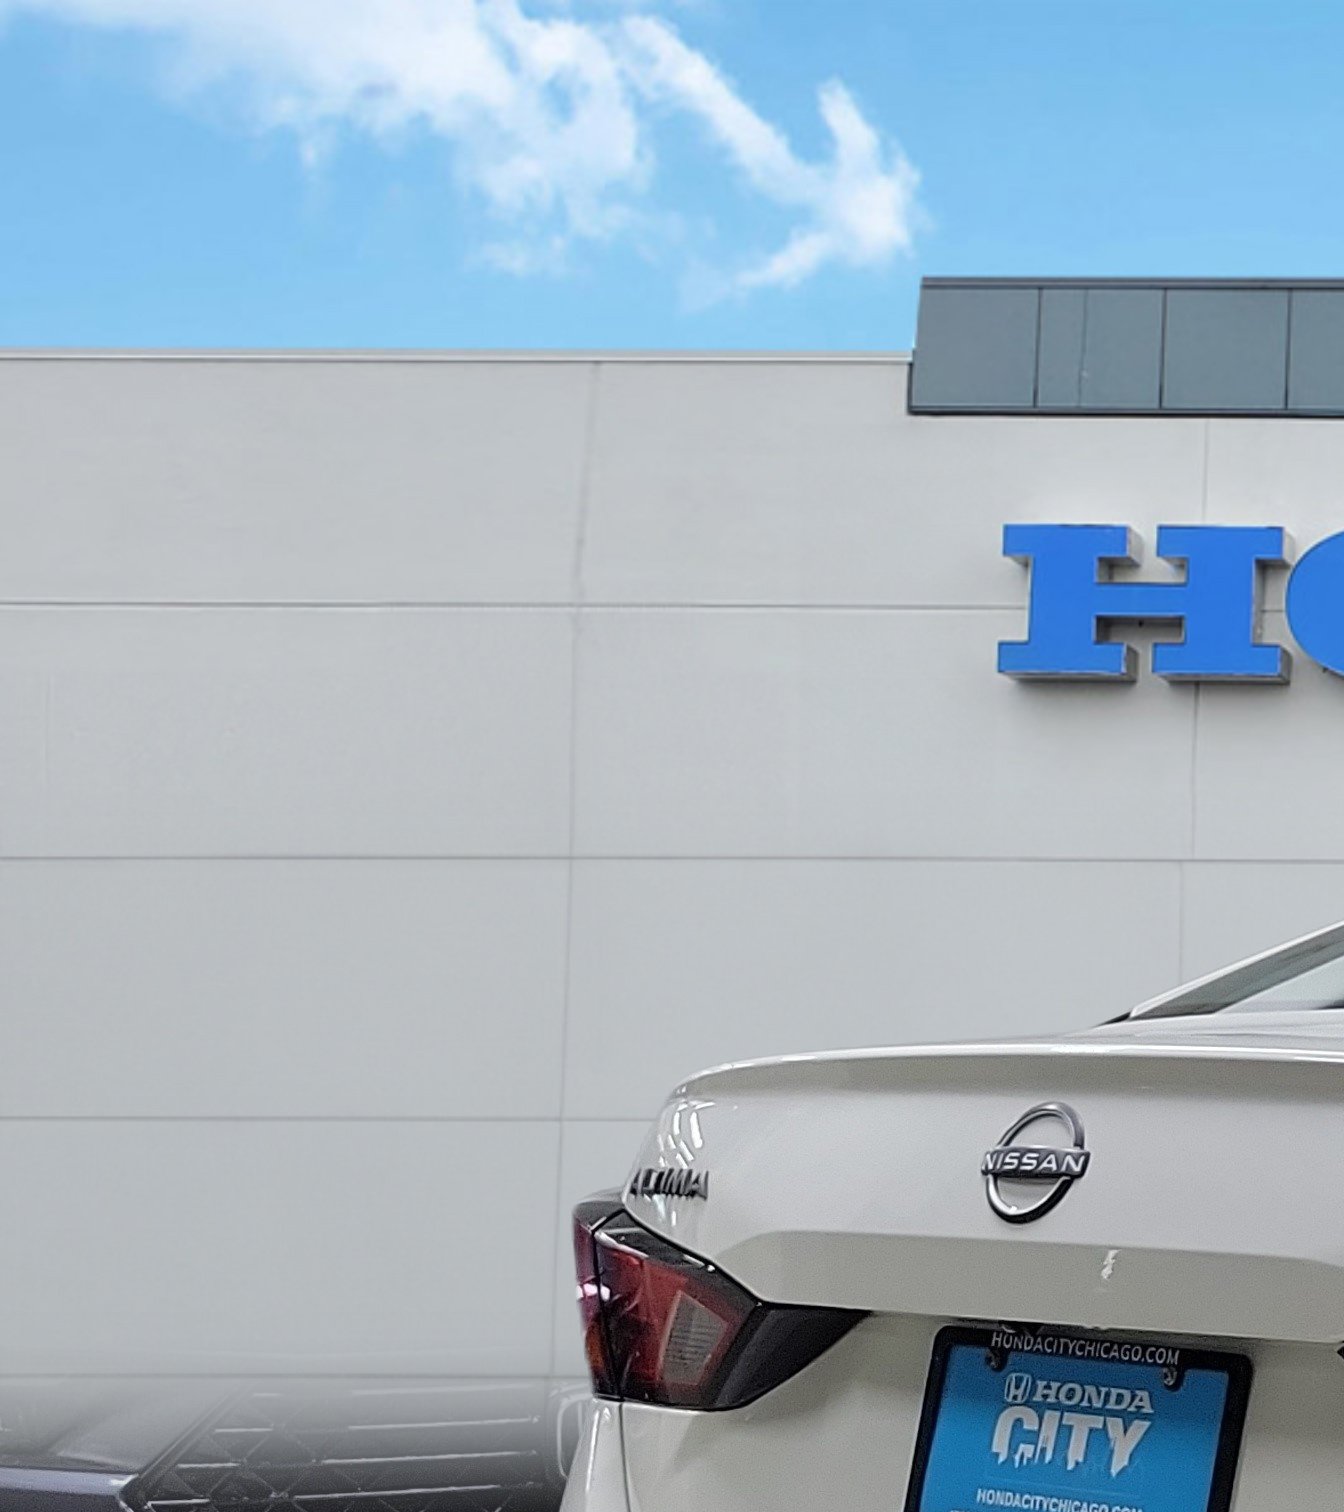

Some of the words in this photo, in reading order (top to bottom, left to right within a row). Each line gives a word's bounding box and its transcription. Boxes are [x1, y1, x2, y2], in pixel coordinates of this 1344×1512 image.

[981, 1149, 1086, 1177] NISSAN
[991, 1331, 1180, 1365] HONDACITYCHICAGO.COM
[1034, 1380, 1154, 1414] HONDA
[990, 1405, 1151, 1478] CITY
